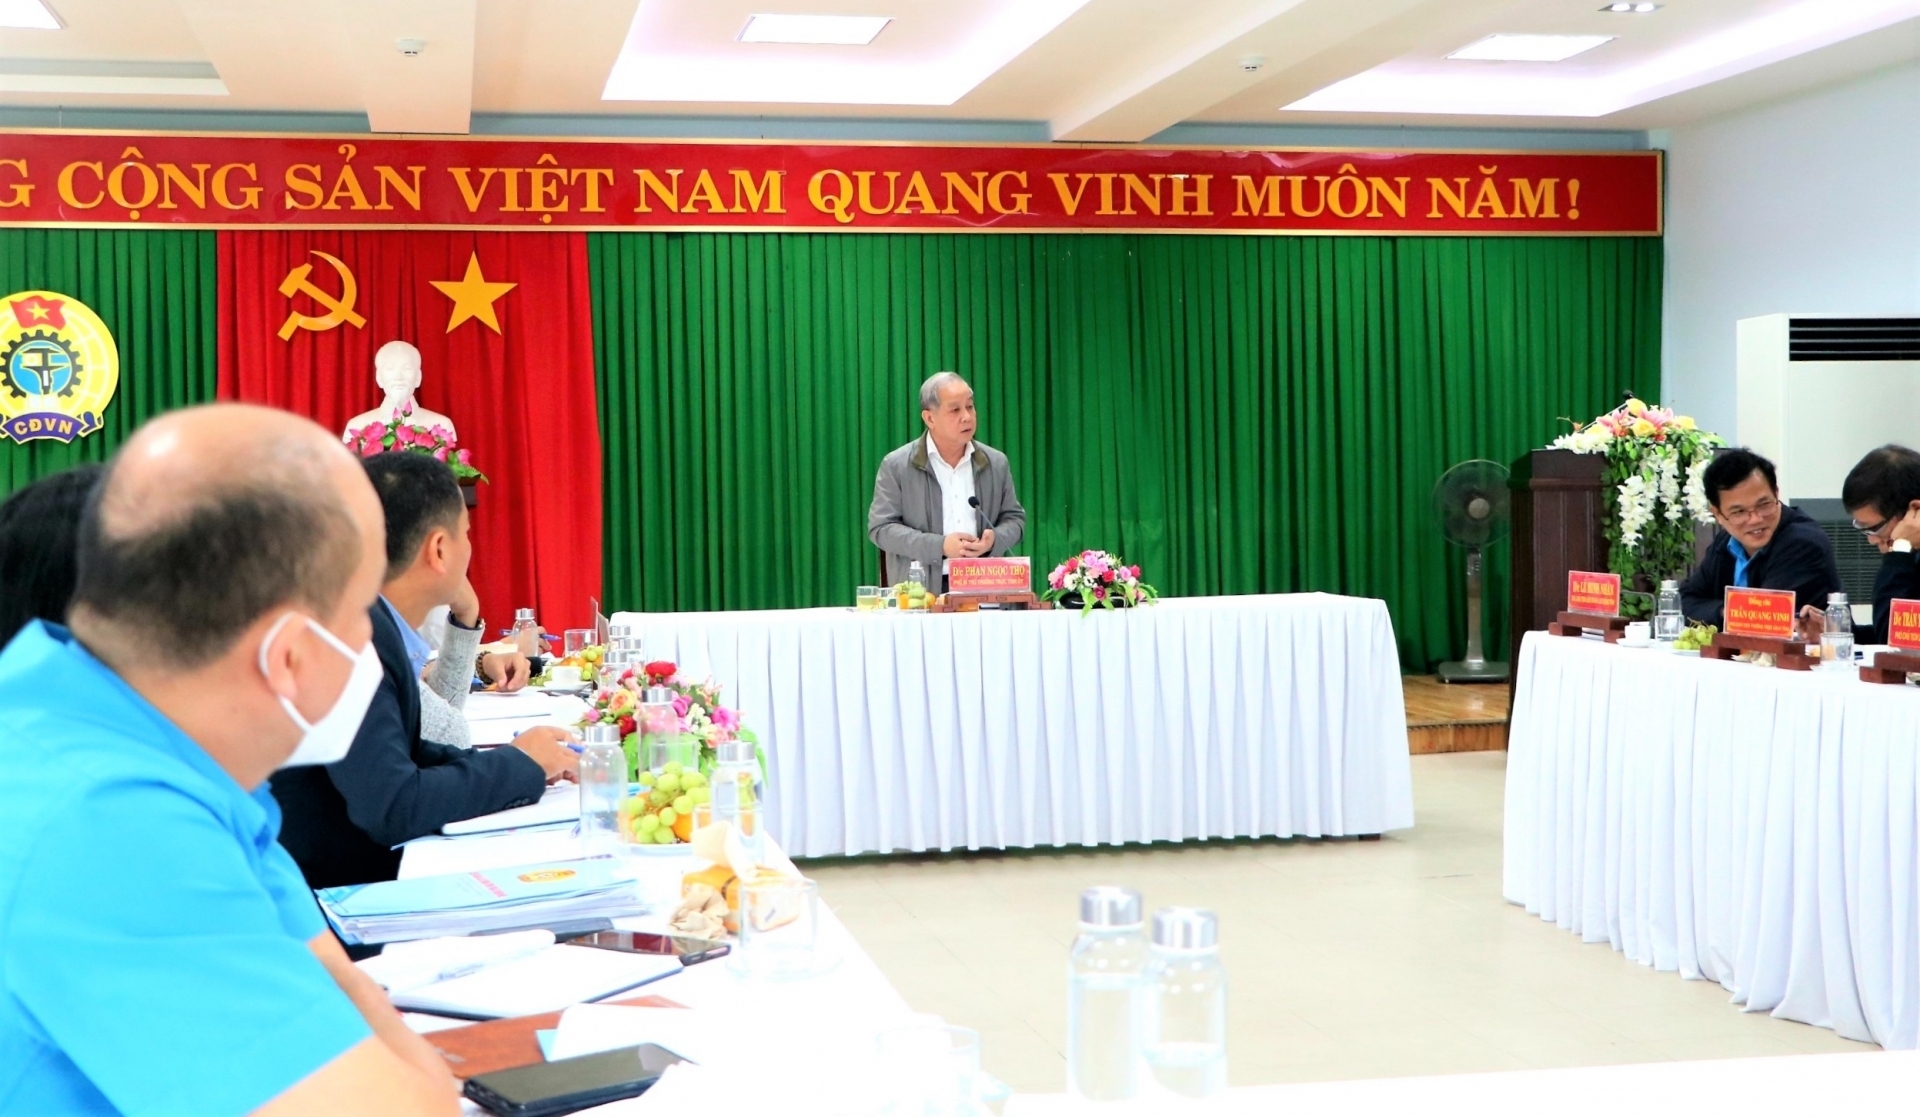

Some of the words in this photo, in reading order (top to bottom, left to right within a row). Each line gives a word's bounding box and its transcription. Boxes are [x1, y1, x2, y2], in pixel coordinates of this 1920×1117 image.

[57, 146, 264, 221] CỘNG
[285, 144, 426, 210] SẢN
[447, 153, 614, 224] VIỆT
[633, 168, 787, 214] NAM
[807, 169, 1032, 224] QUANG
[1047, 173, 1214, 216] VINH
[1232, 163, 1411, 218] MUÔN
[965, 566, 986, 576] PHAN
[987, 565, 1008, 578] NGỌC
[1748, 609, 1771, 621] QUANG
[1772, 612, 1790, 622] VINH
